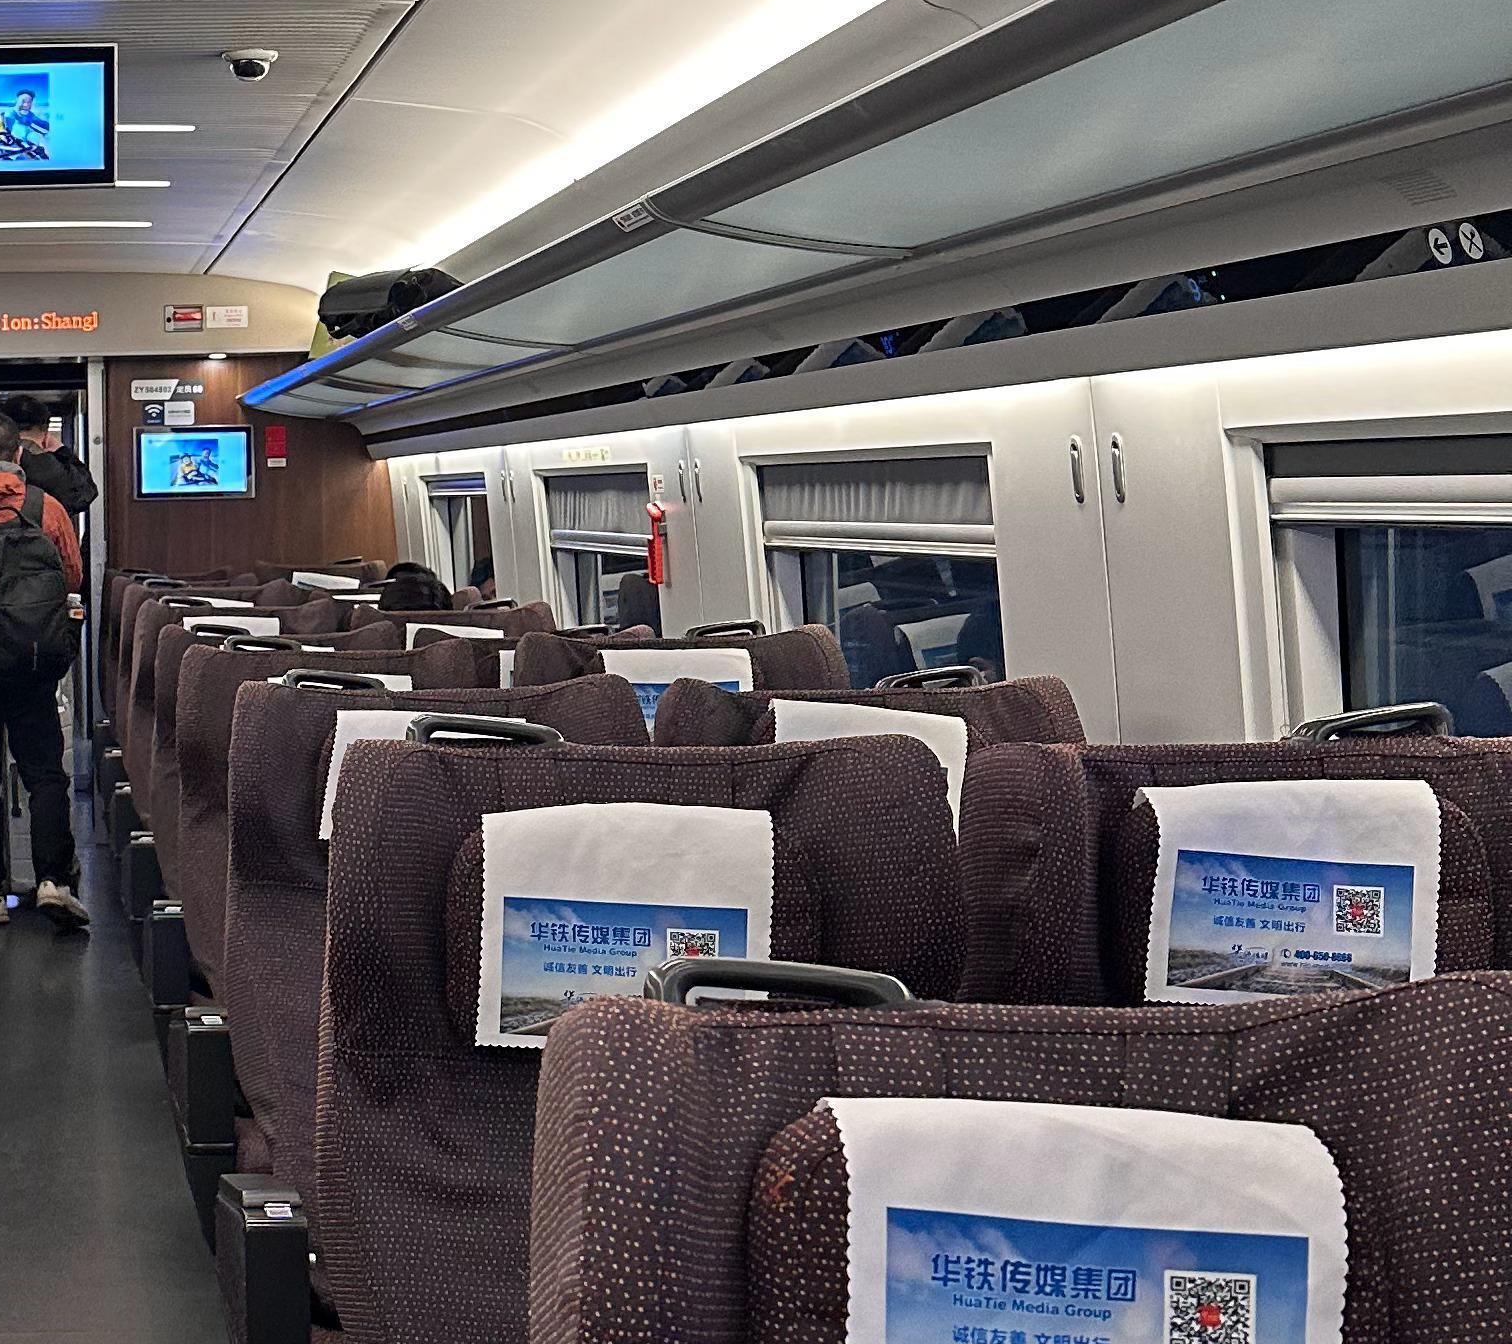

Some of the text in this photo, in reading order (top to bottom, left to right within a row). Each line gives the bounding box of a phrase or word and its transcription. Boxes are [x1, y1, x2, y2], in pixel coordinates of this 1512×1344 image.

[1202, 875, 1321, 903] 华铁传媒集团
[530, 921, 651, 947] 华铁传媒集团
[1259, 919, 1306, 933] 文明出行
[609, 948, 638, 957] Group
[592, 964, 638, 977] 文明出行
[931, 1253, 1137, 1302] 华铁传媒集团
[953, 1293, 1112, 1321] HuaTie Media Group
